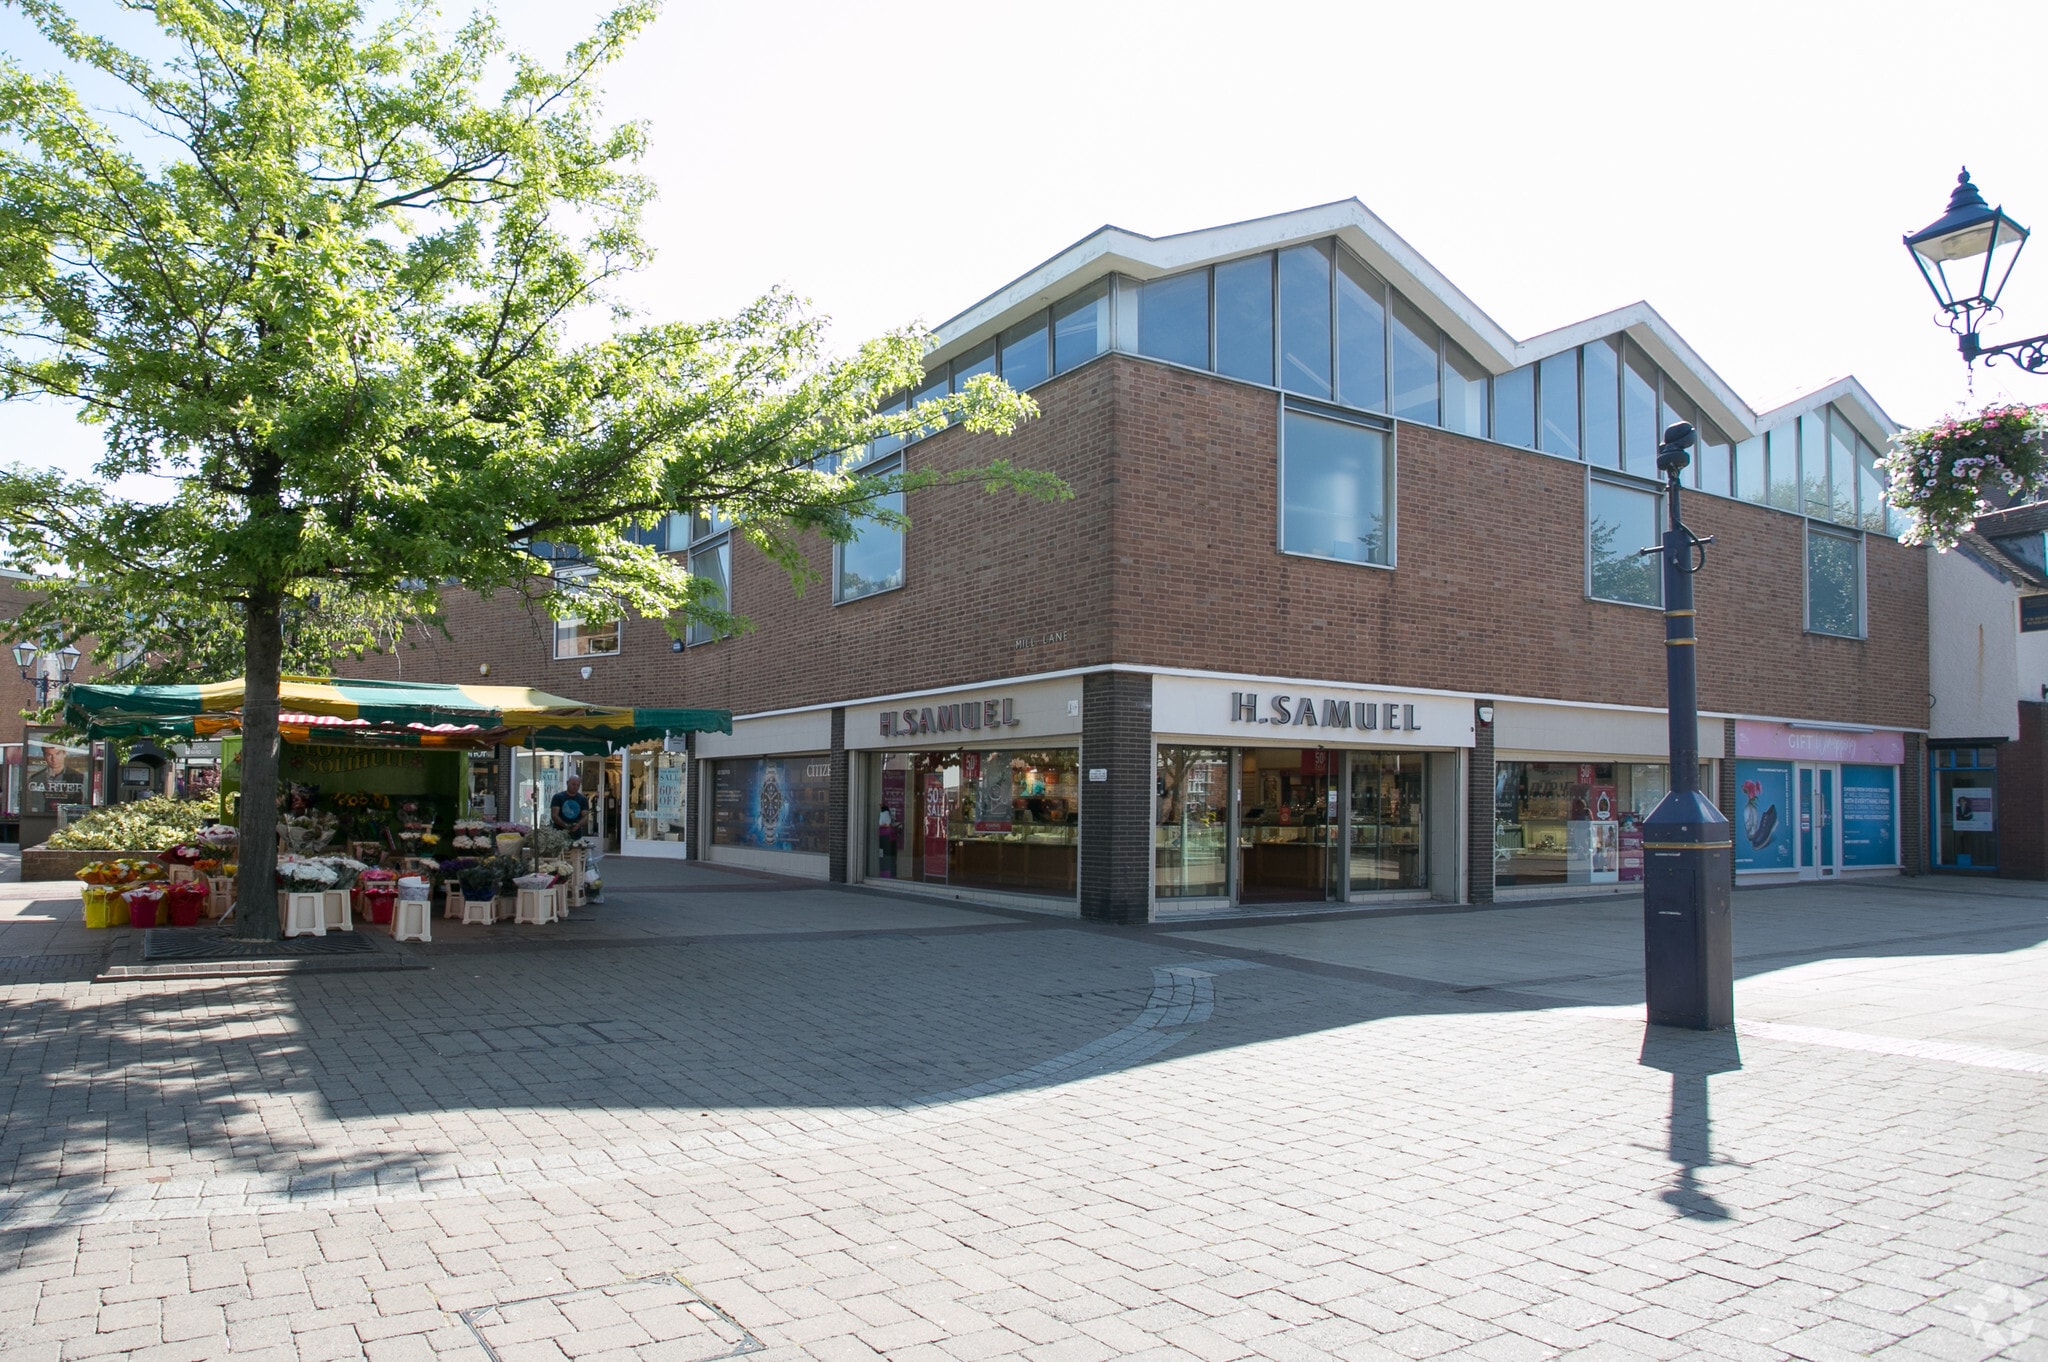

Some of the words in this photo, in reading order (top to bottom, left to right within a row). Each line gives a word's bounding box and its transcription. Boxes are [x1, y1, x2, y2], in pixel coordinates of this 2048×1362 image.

[1015, 638, 1035, 650] MILL
[1043, 630, 1069, 644] LANE
[879, 697, 1020, 737] H.SAMUEL
[1231, 691, 1422, 731] H.SAMUEL
[1788, 733, 1813, 750] GIFT
[305, 749, 409, 774] SOLIHULL
[806, 763, 832, 778] CITIZE
[660, 774, 679, 782] SALE
[659, 796, 679, 806] OFF
